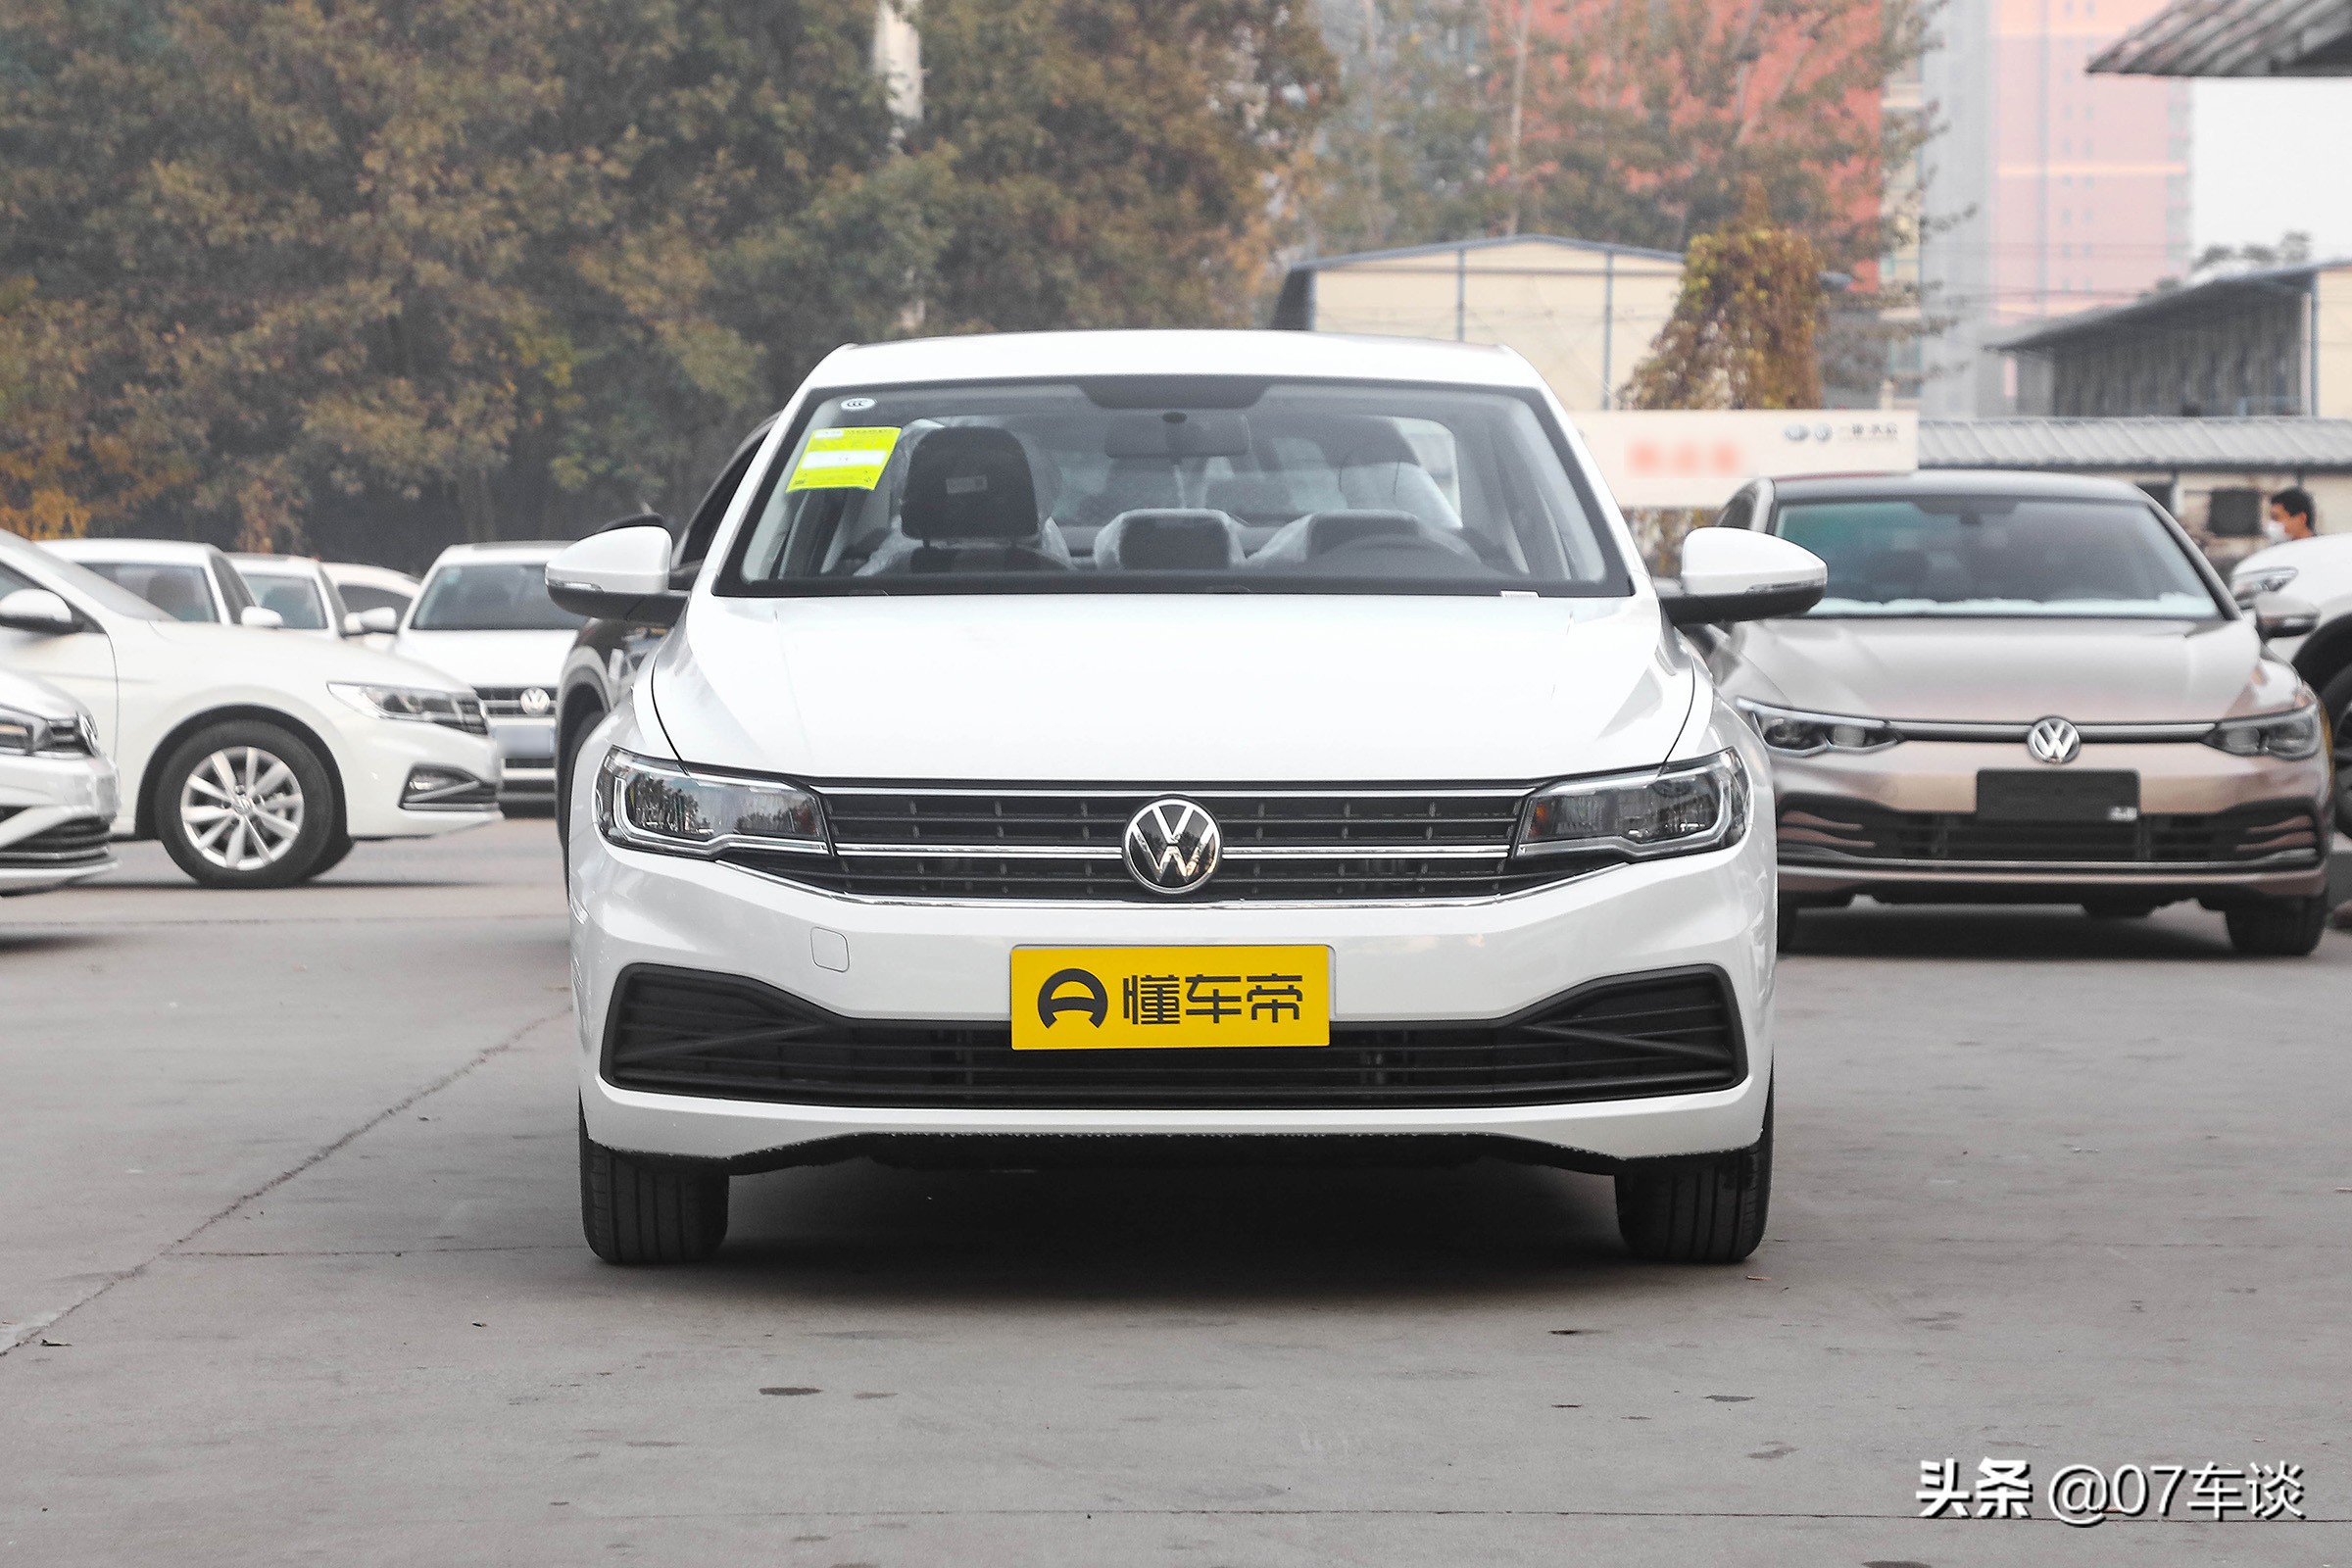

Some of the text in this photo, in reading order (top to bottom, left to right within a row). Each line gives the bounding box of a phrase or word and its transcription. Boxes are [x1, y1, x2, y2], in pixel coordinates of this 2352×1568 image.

[1127, 801, 1218, 888] VW
[1123, 973, 1303, 1025] 懂车帝
